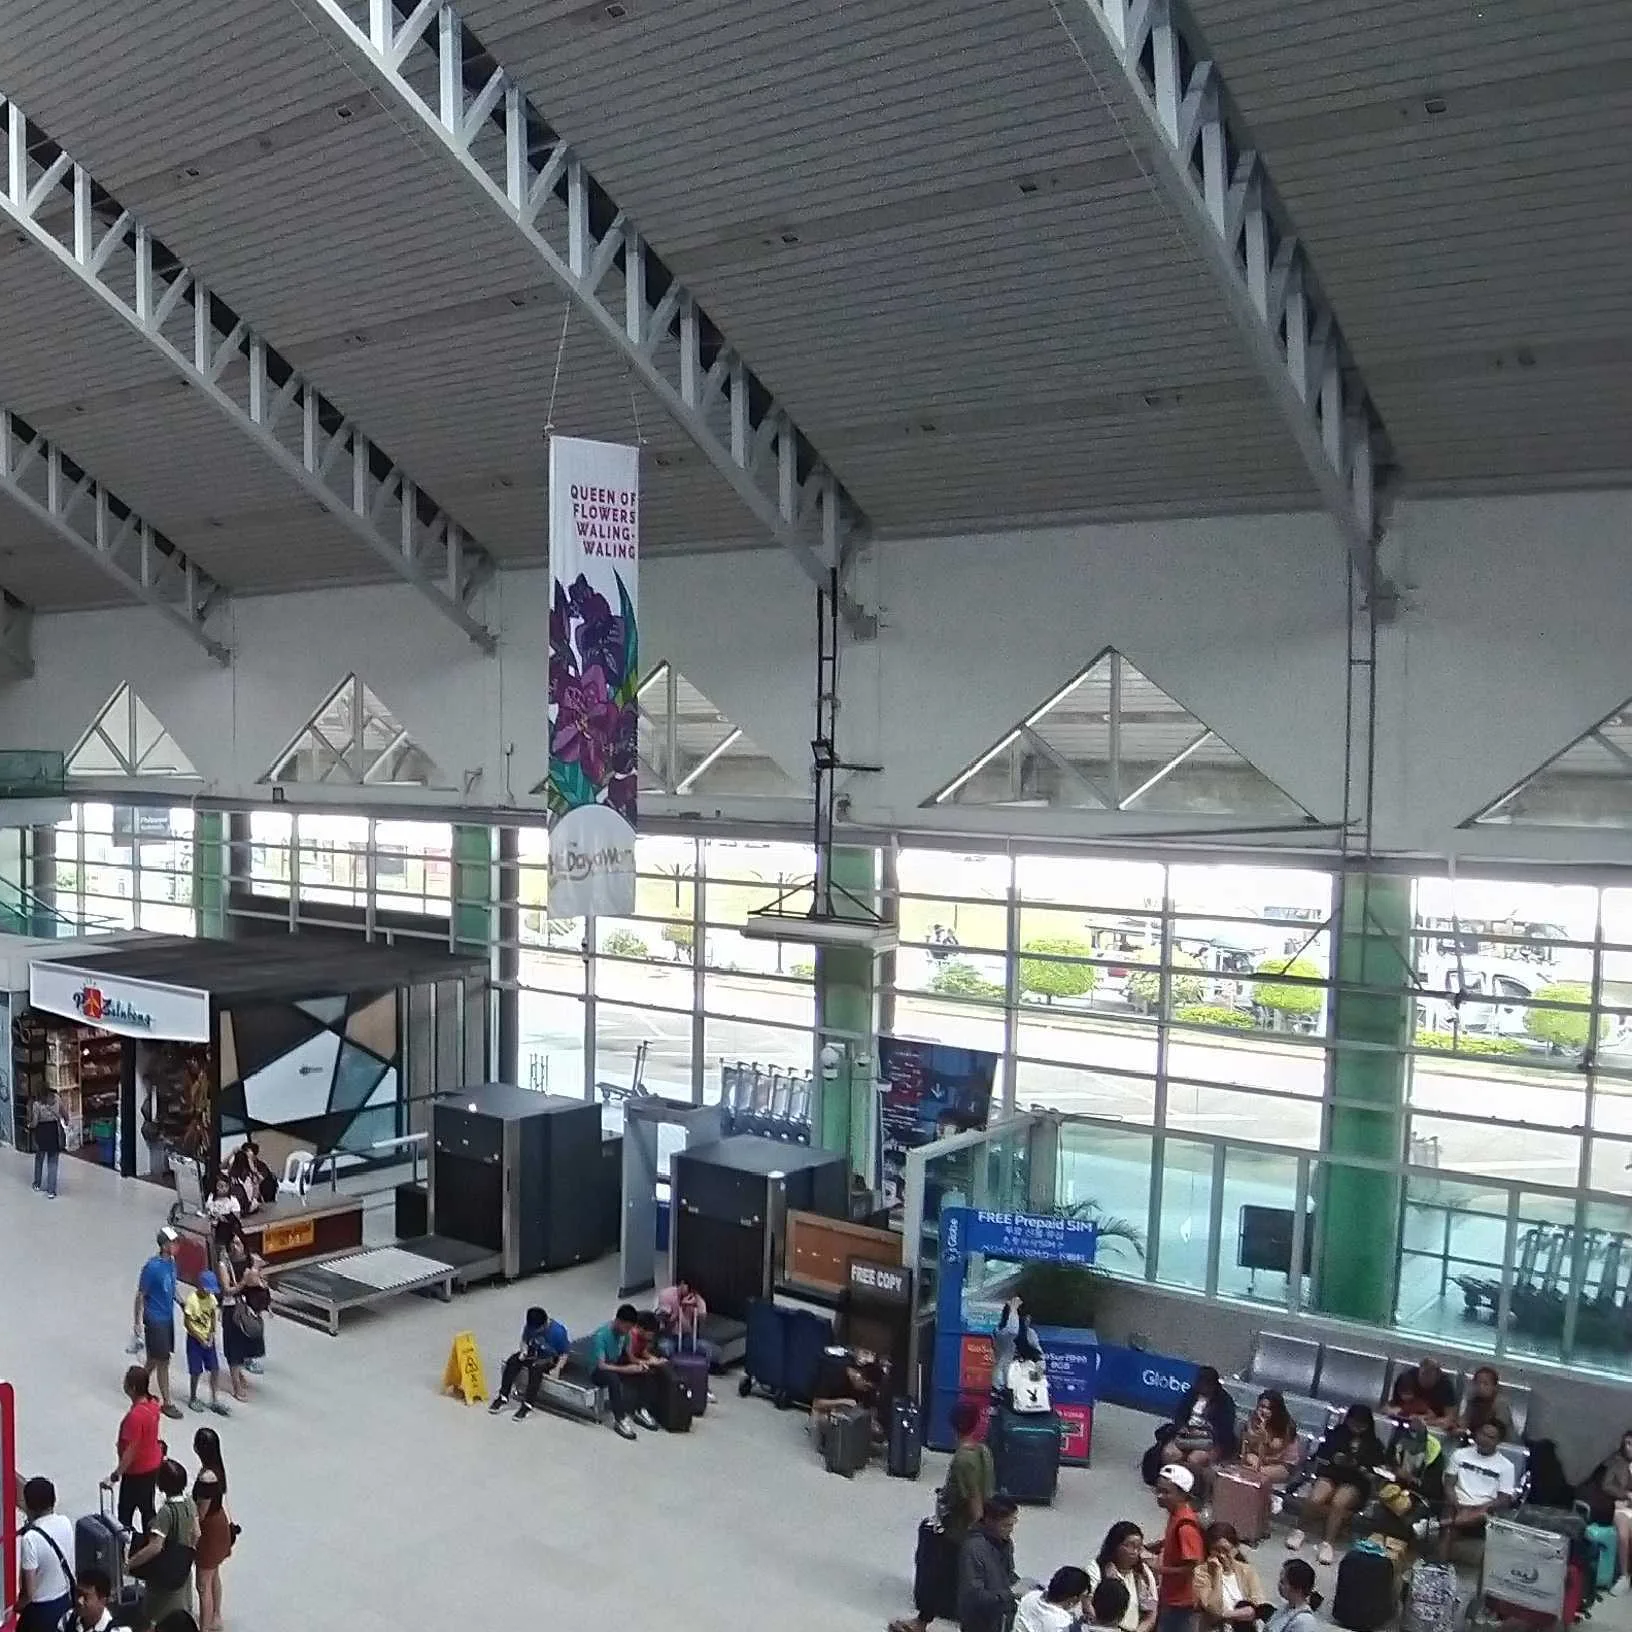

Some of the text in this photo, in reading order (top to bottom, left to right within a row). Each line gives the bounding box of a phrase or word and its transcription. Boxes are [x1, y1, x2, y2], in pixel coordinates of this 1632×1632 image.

[570, 484, 637, 507] QUEEN OF
[573, 503, 637, 525] FLOWERS
[576, 520, 636, 541] WALING-
[582, 540, 636, 560] WALING
[977, 1210, 1013, 1225] FREE
[1014, 1215, 1065, 1232] Prepaid
[1066, 1220, 1093, 1233] SIM
[850, 1263, 903, 1292] FREE COPY
[1141, 1368, 1193, 1394] Globe
